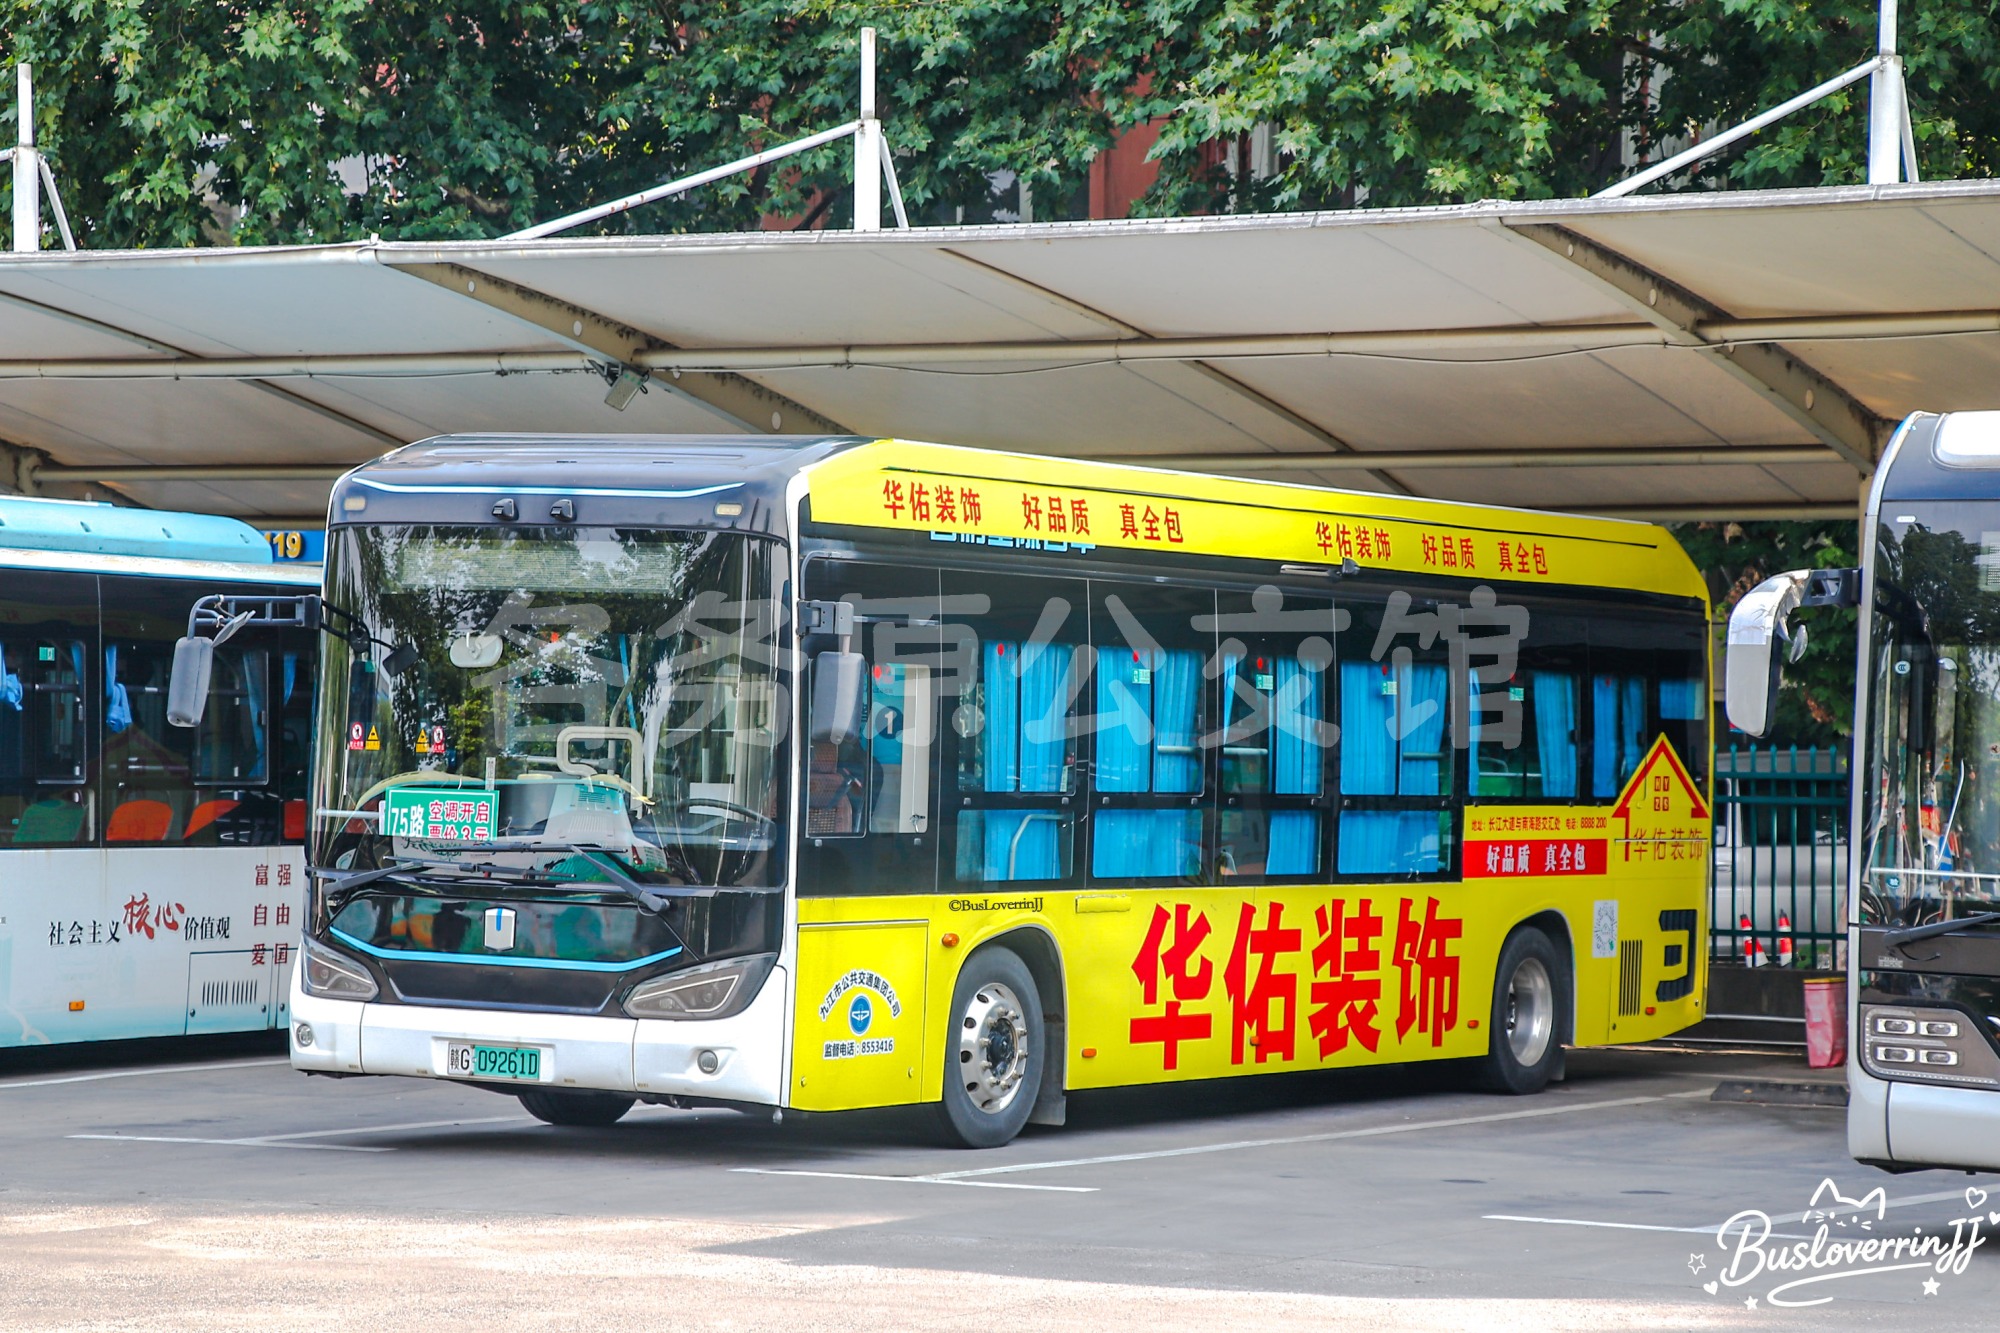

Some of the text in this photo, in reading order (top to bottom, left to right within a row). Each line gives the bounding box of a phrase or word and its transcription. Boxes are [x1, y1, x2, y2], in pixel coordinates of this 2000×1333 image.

[883, 479, 982, 527] 华佑装饰
[1022, 493, 1090, 536] 好品质
[1119, 502, 1183, 543] 真全包
[264, 531, 302, 558] 19
[1315, 521, 1548, 575] 华佑装饰 好品质 真全包
[391, 804, 424, 837] 75路
[429, 801, 489, 823] 空调开启
[1486, 842, 1586, 874] 好品质 真全包
[1633, 827, 1703, 862] 华佑装饰
[255, 863, 291, 886] 富强
[48, 892, 230, 946] 社会主义核心价值观
[253, 903, 290, 927] 自由
[251, 943, 288, 966] 爱国
[819, 971, 901, 1019] 九江市公共交通集团公司
[1130, 896, 1463, 1071] 华佑装饰
